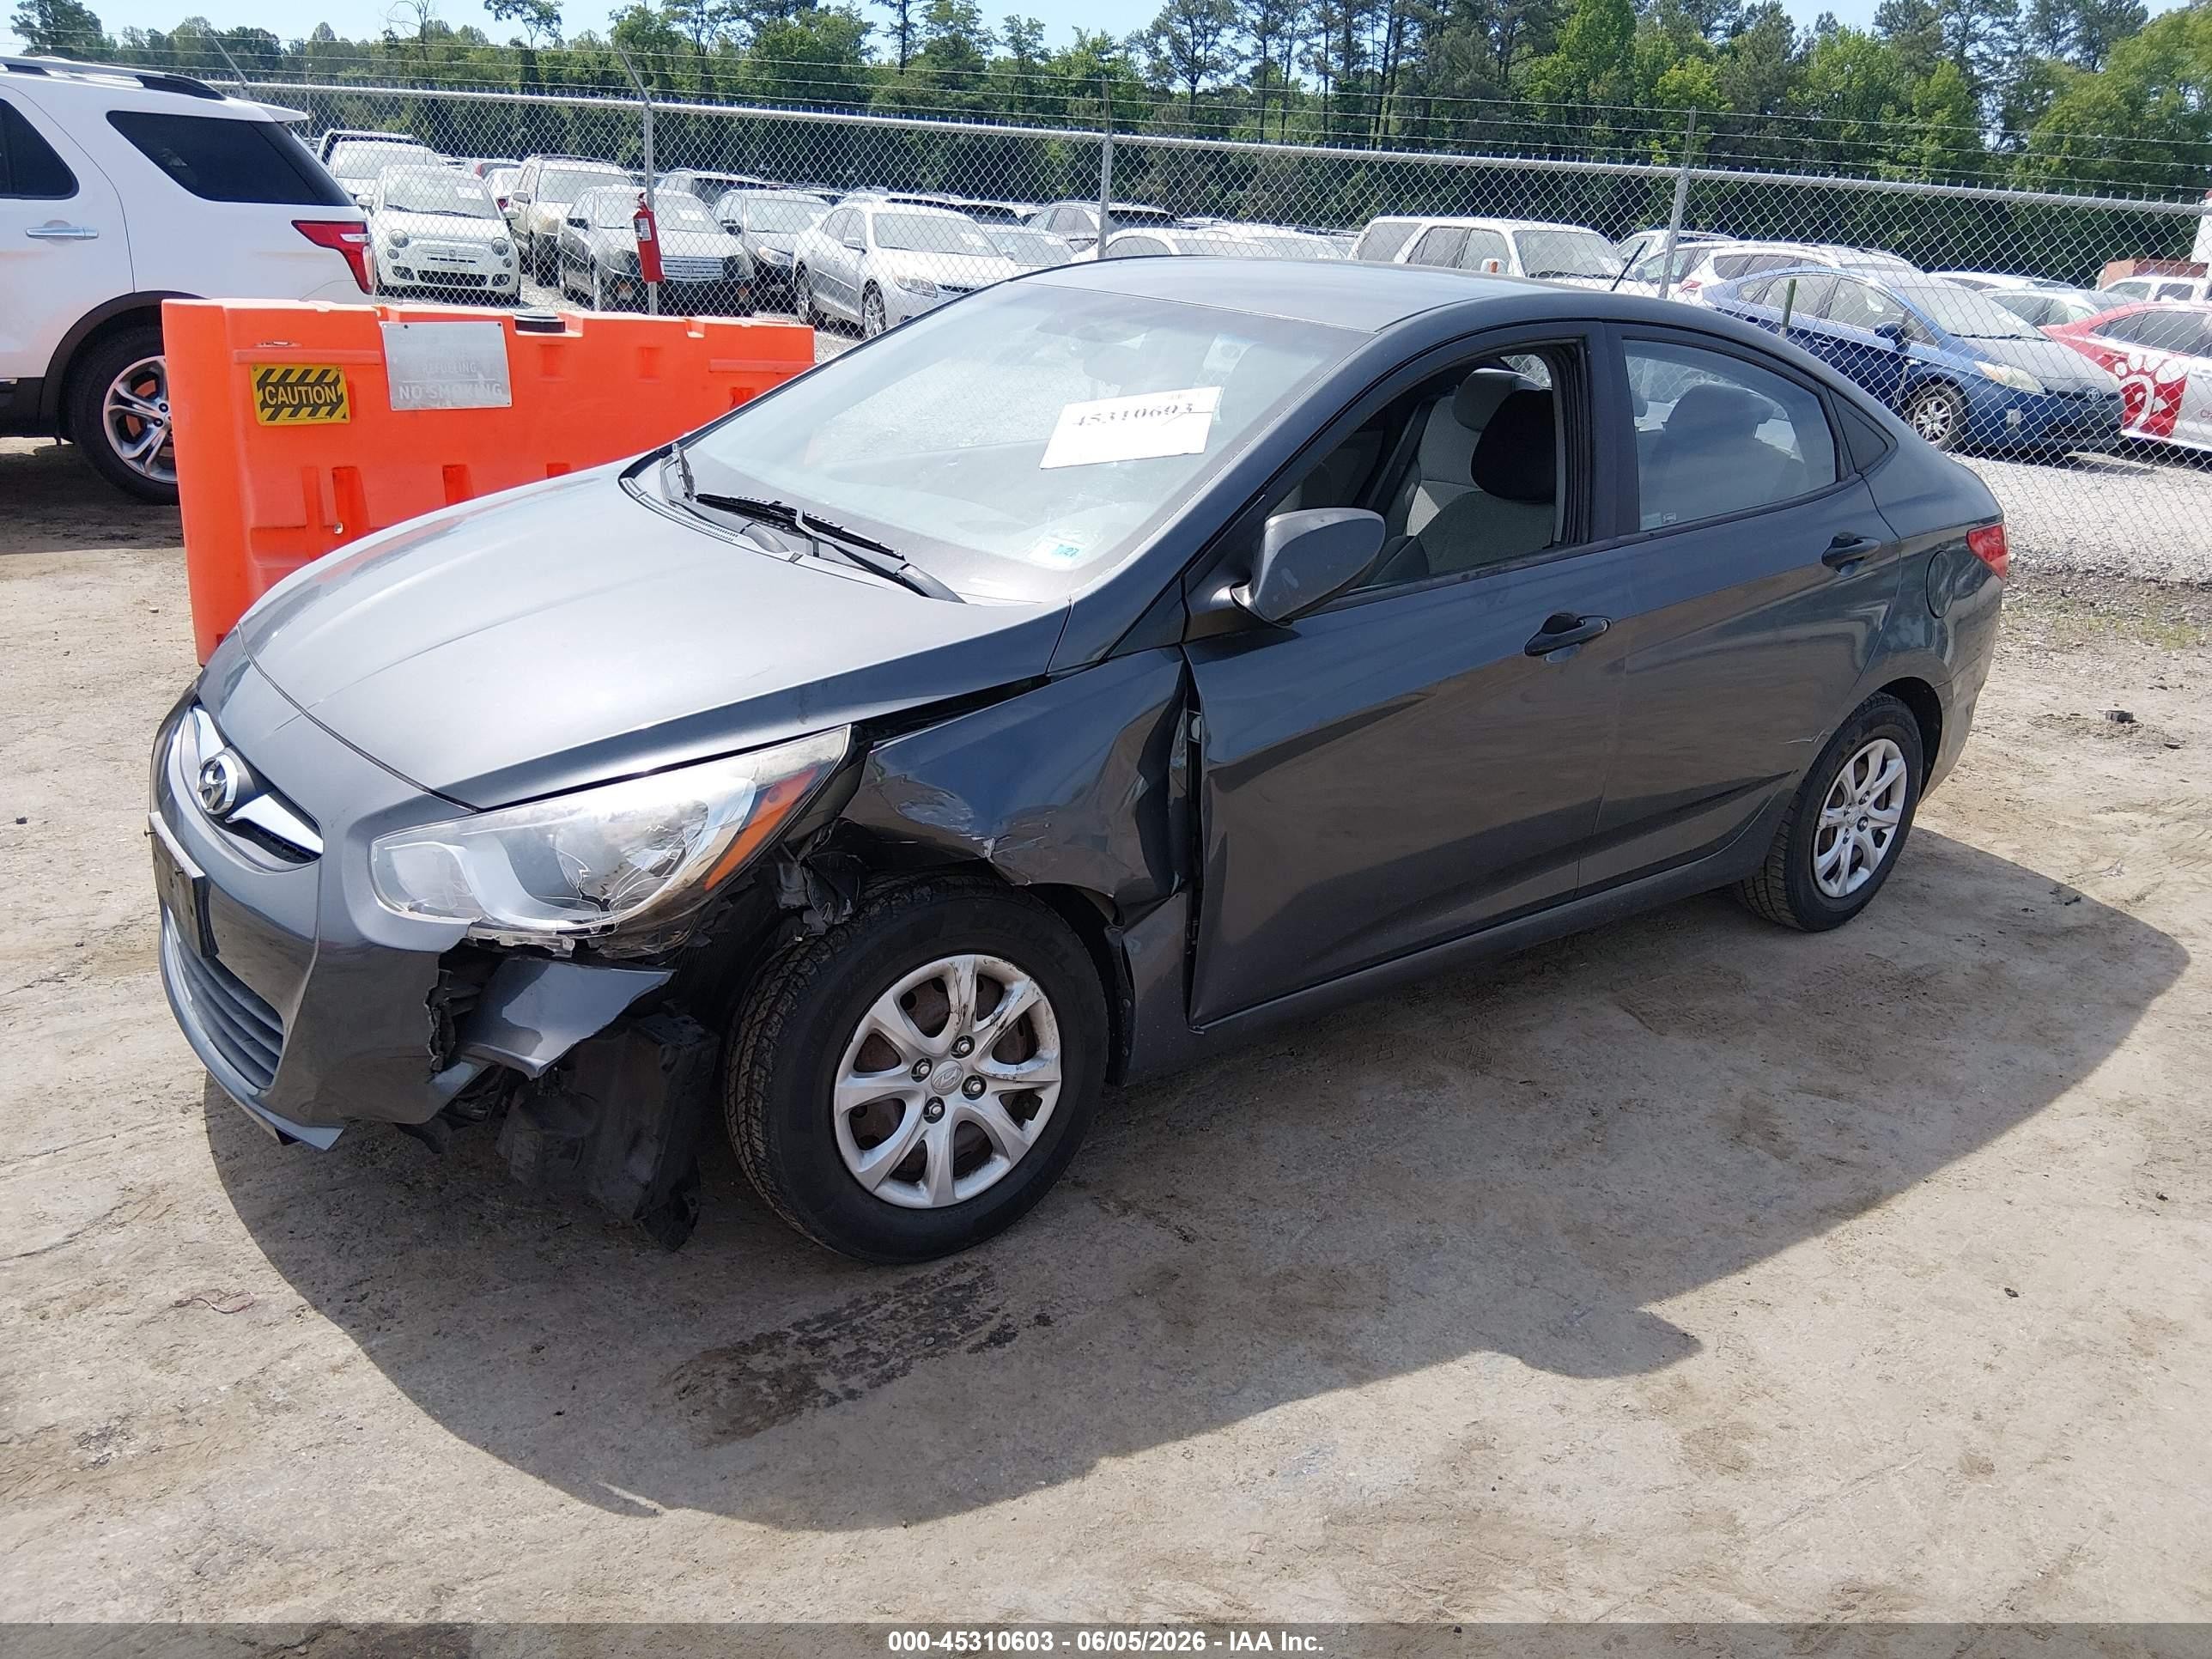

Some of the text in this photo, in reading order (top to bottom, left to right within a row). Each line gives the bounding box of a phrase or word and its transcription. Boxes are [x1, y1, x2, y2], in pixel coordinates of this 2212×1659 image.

[264, 385, 337, 405] CAUTION
[398, 383, 502, 399] NO SMOKING
